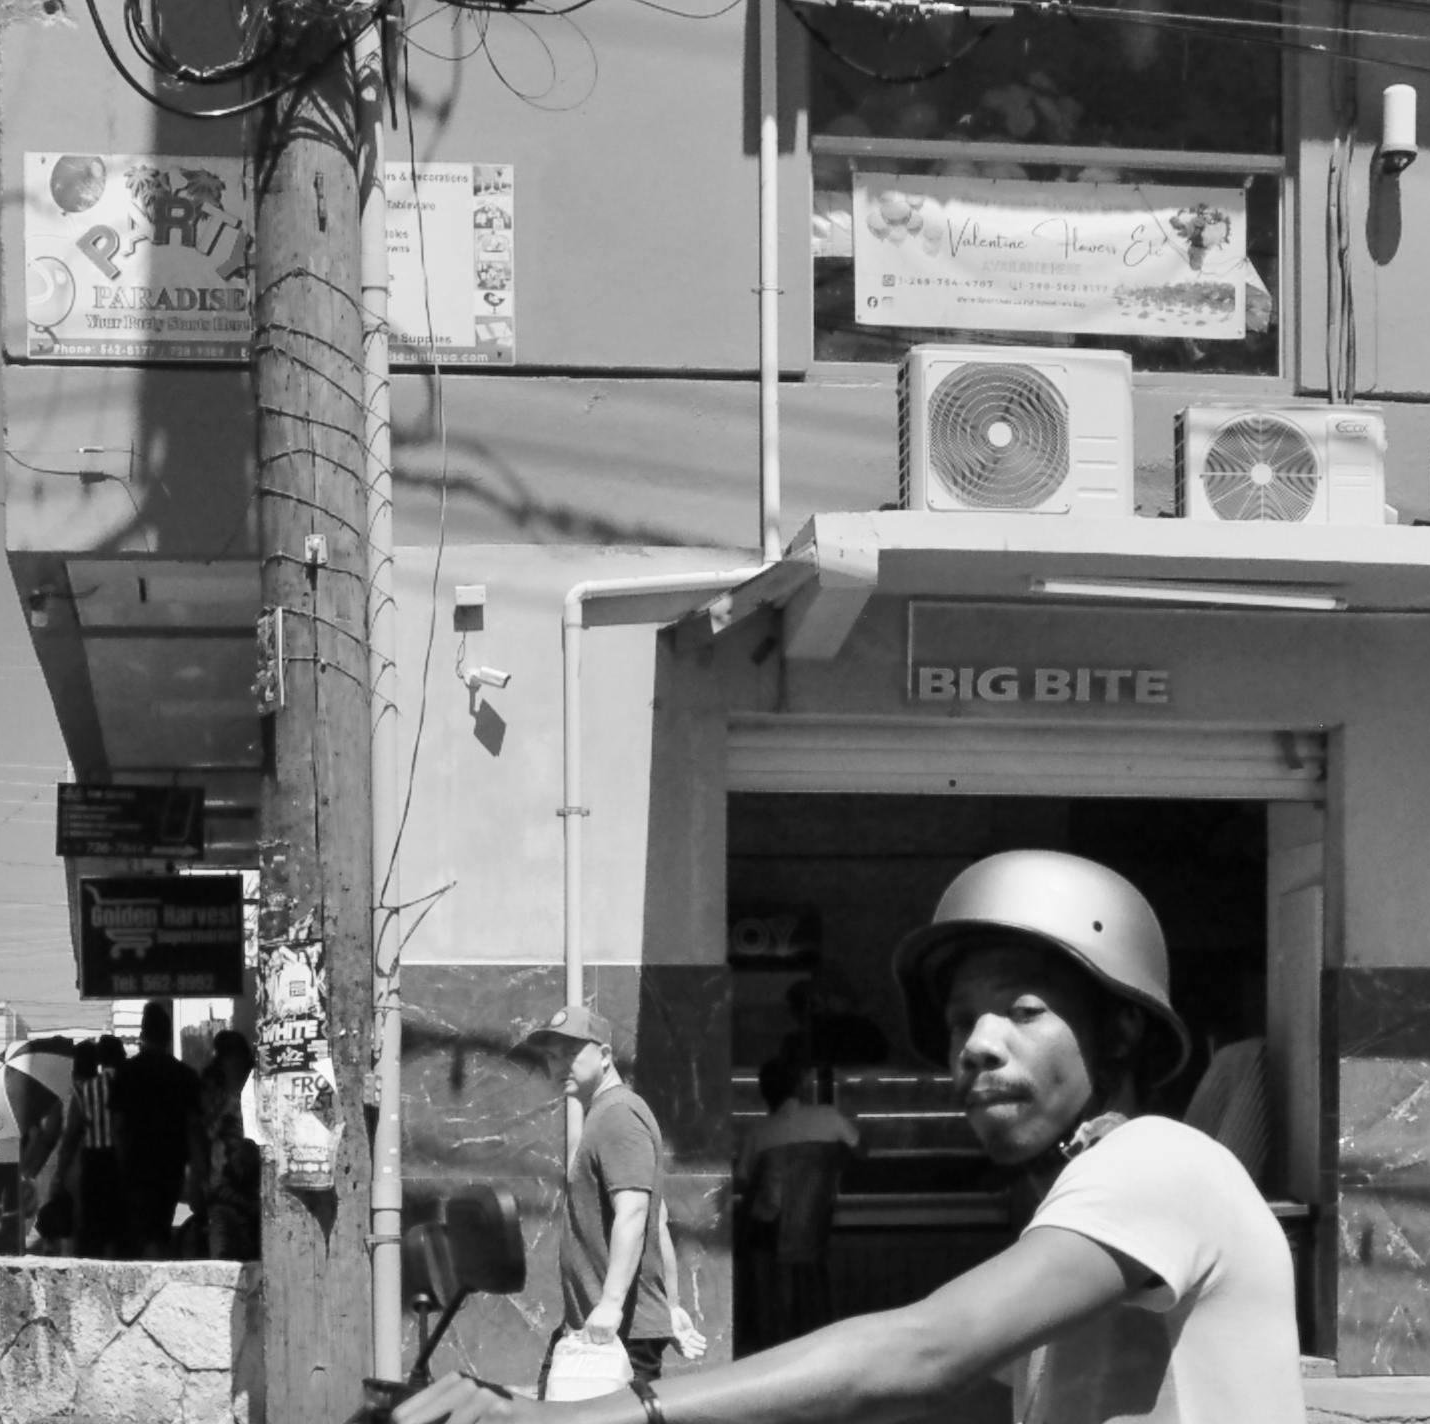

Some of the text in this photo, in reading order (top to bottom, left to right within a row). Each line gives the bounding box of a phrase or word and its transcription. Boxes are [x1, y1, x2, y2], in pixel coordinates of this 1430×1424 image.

[947, 217, 1027, 258] Valentine
[1031, 217, 1118, 260] Flowers
[92, 285, 246, 311] PARADISE
[919, 666, 1169, 703] BIG BITE
[91, 903, 238, 928] Golden Harvest
[262, 1019, 319, 1044] WHITE
